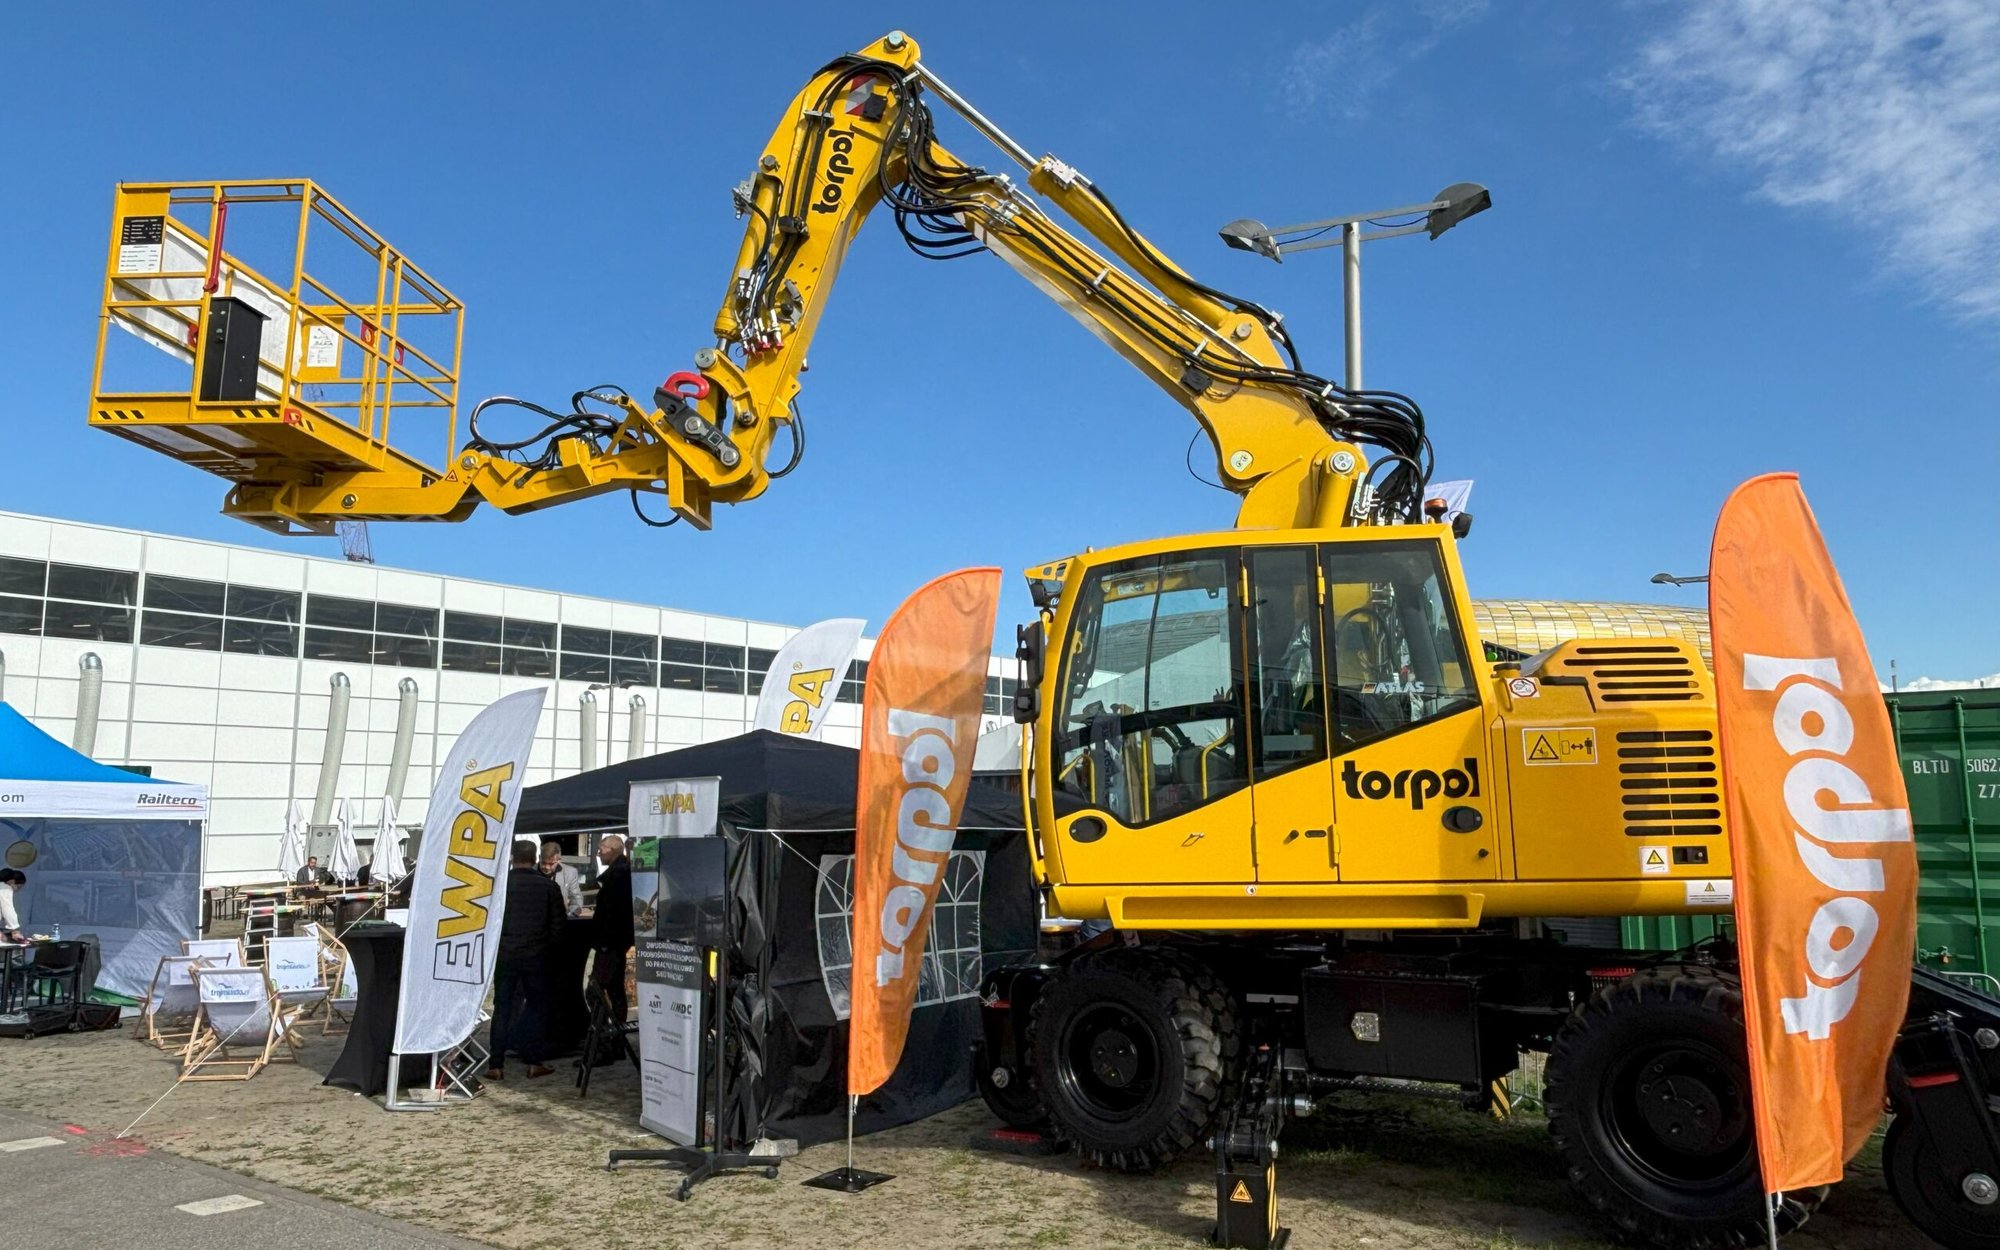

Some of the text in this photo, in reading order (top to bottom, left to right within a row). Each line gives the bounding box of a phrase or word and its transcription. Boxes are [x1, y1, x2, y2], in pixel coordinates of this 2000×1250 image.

[812, 129, 854, 214] torpol
[1375, 681, 1425, 694] ATLAS
[1341, 758, 1480, 810] torpol
[1912, 759, 1950, 774] BLTU
[137, 793, 198, 805] Railteco
[649, 792, 696, 815] EWPA
[876, 707, 956, 987] torpol
[1743, 653, 1911, 1040] torpol
